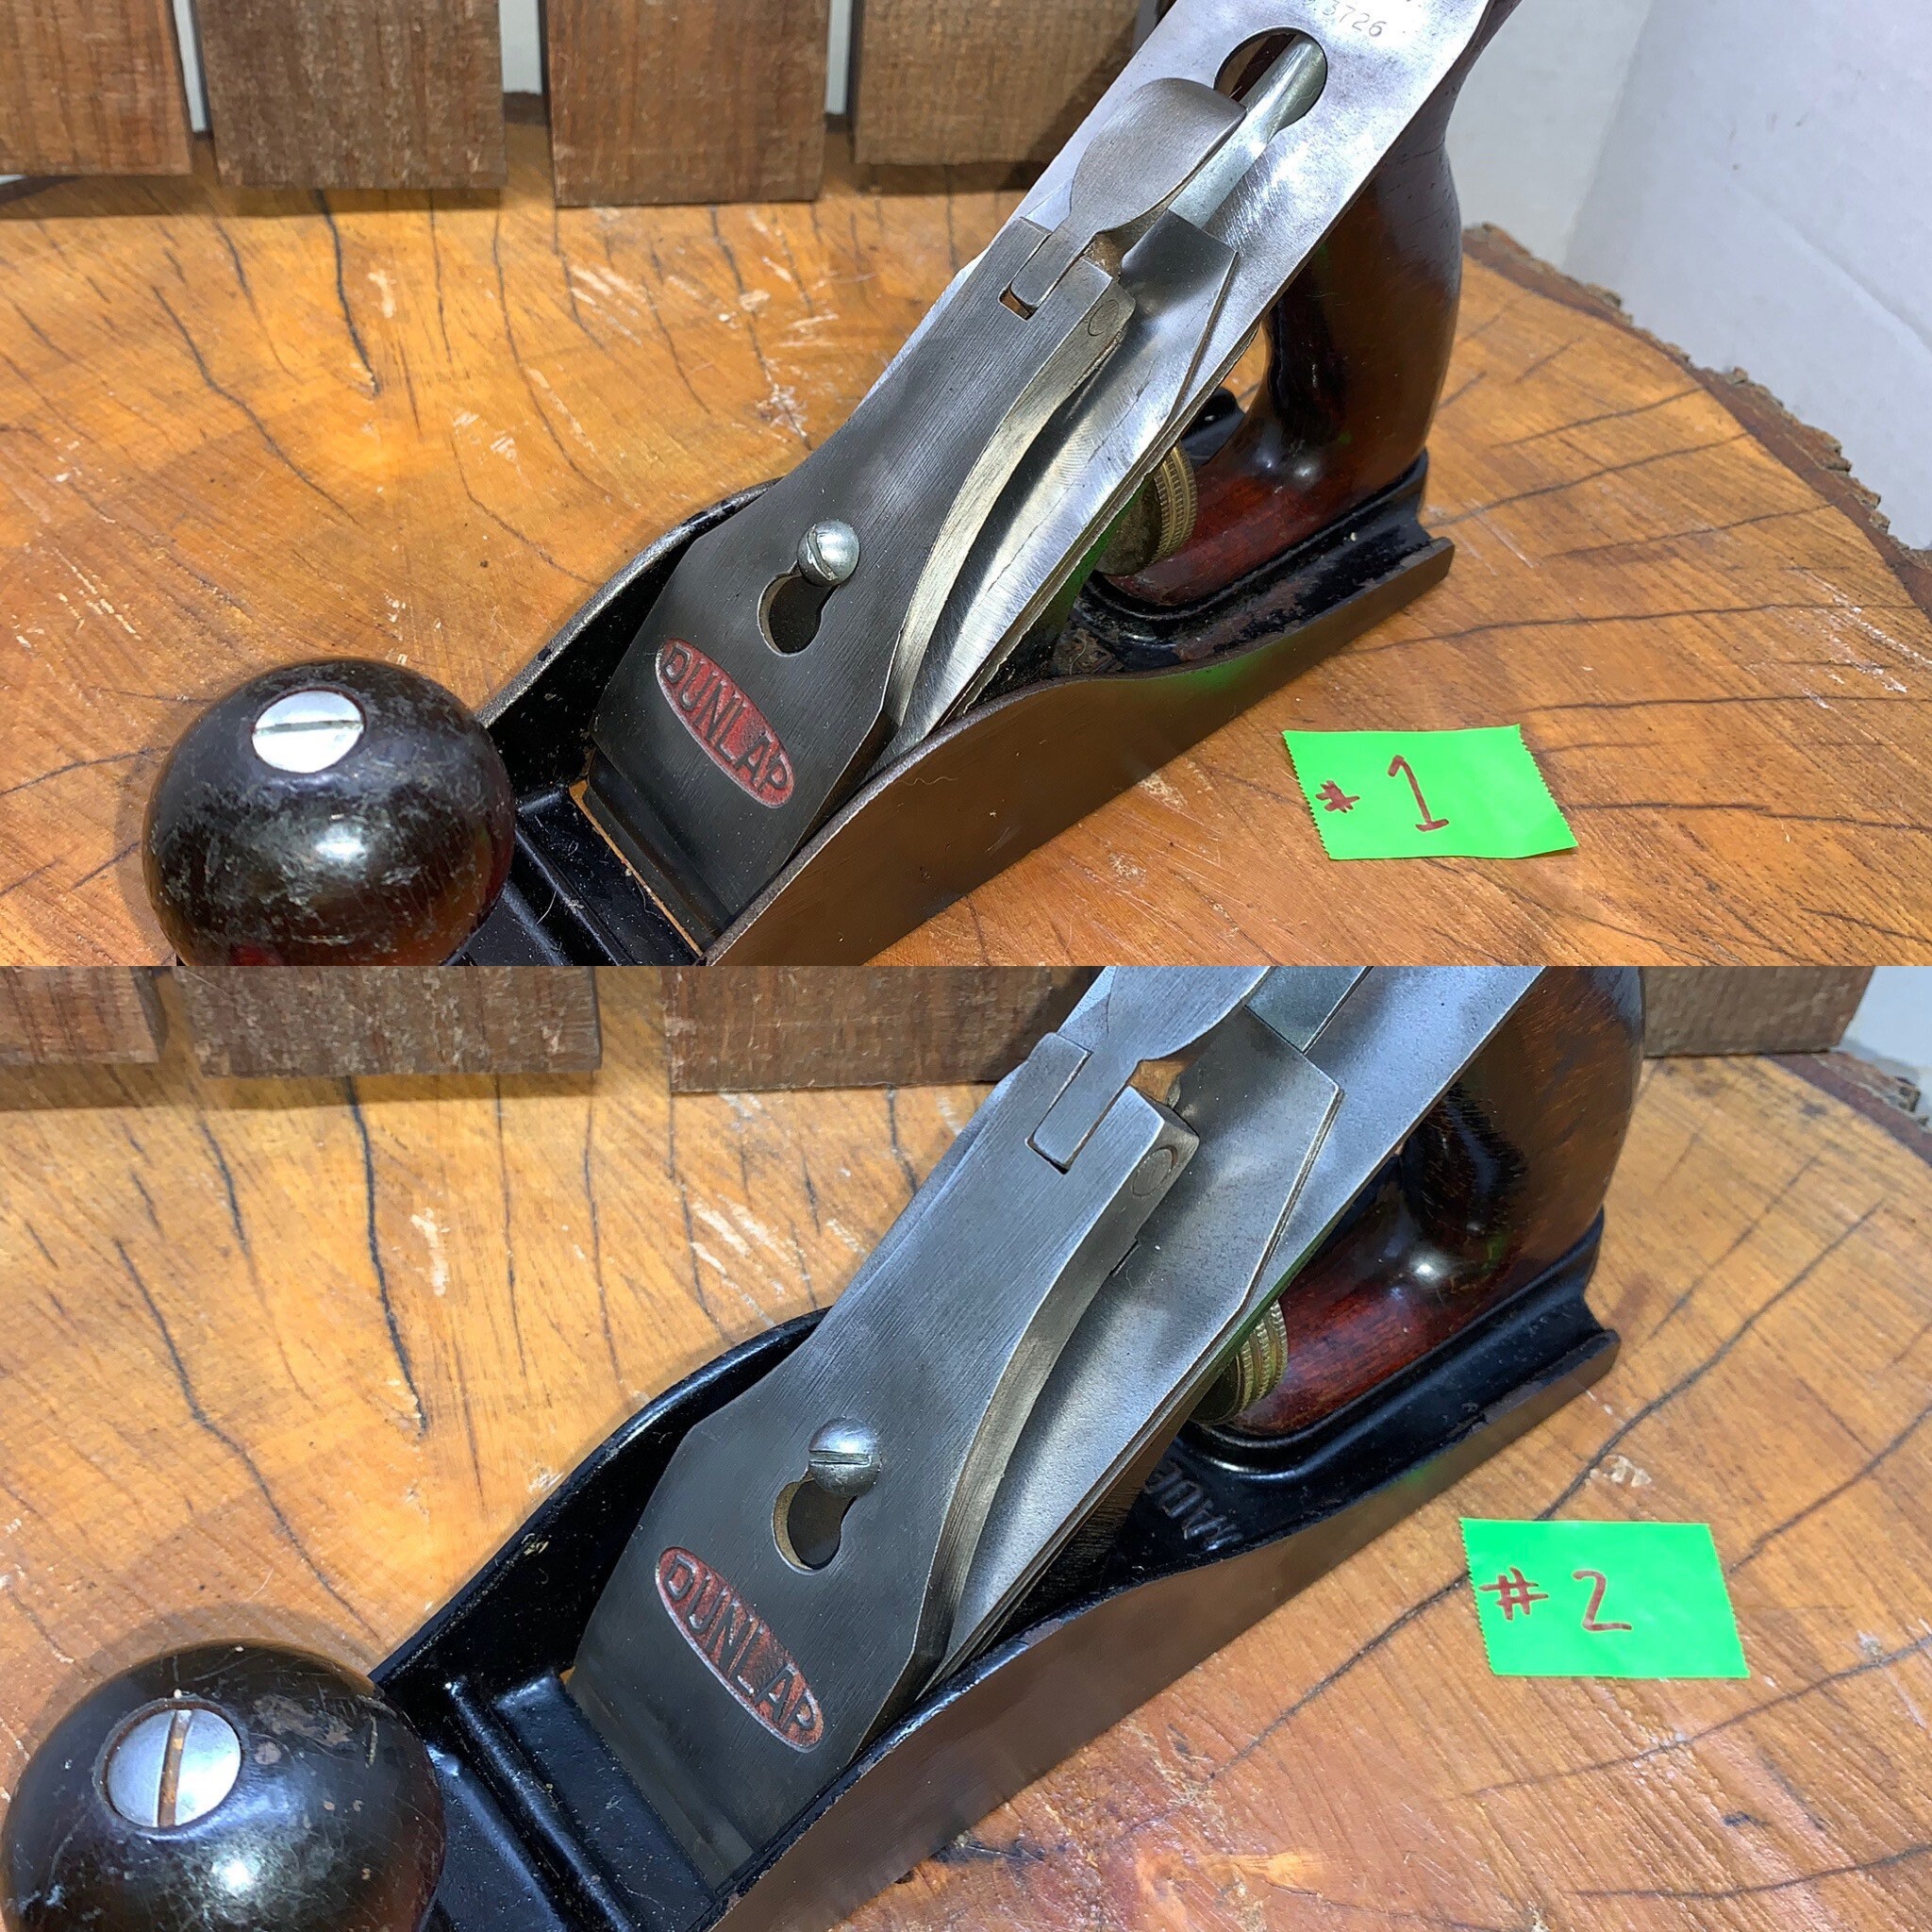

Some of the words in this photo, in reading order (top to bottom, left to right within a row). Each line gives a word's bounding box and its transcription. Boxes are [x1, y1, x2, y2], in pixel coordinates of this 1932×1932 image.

[662, 644, 789, 791] DUNLAP
[664, 1555, 819, 1729] DUNLAP
[1572, 1570, 1632, 1631] 2
